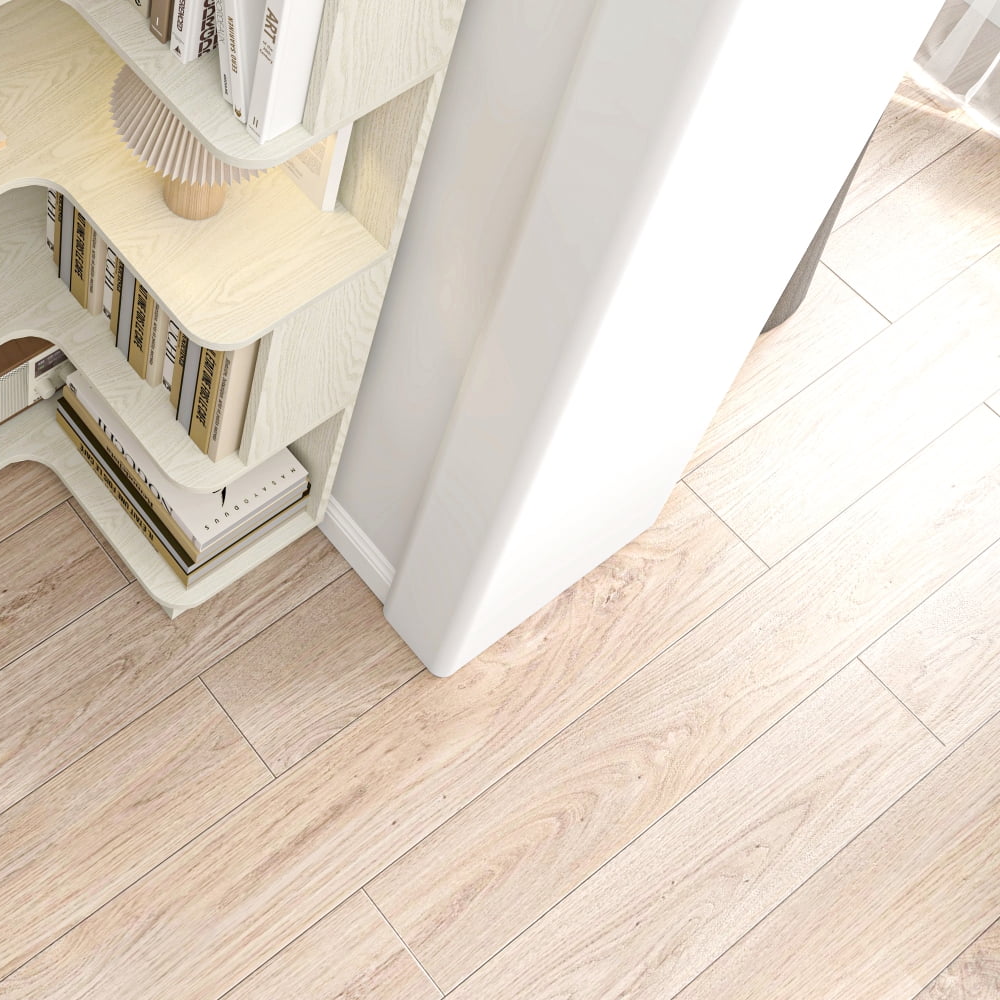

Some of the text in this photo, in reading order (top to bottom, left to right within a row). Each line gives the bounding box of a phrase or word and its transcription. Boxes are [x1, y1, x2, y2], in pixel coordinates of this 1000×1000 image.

[228, 16, 236, 53] SAARINEN
[264, 7, 279, 44] ART
[204, 505, 240, 531] DUUS
